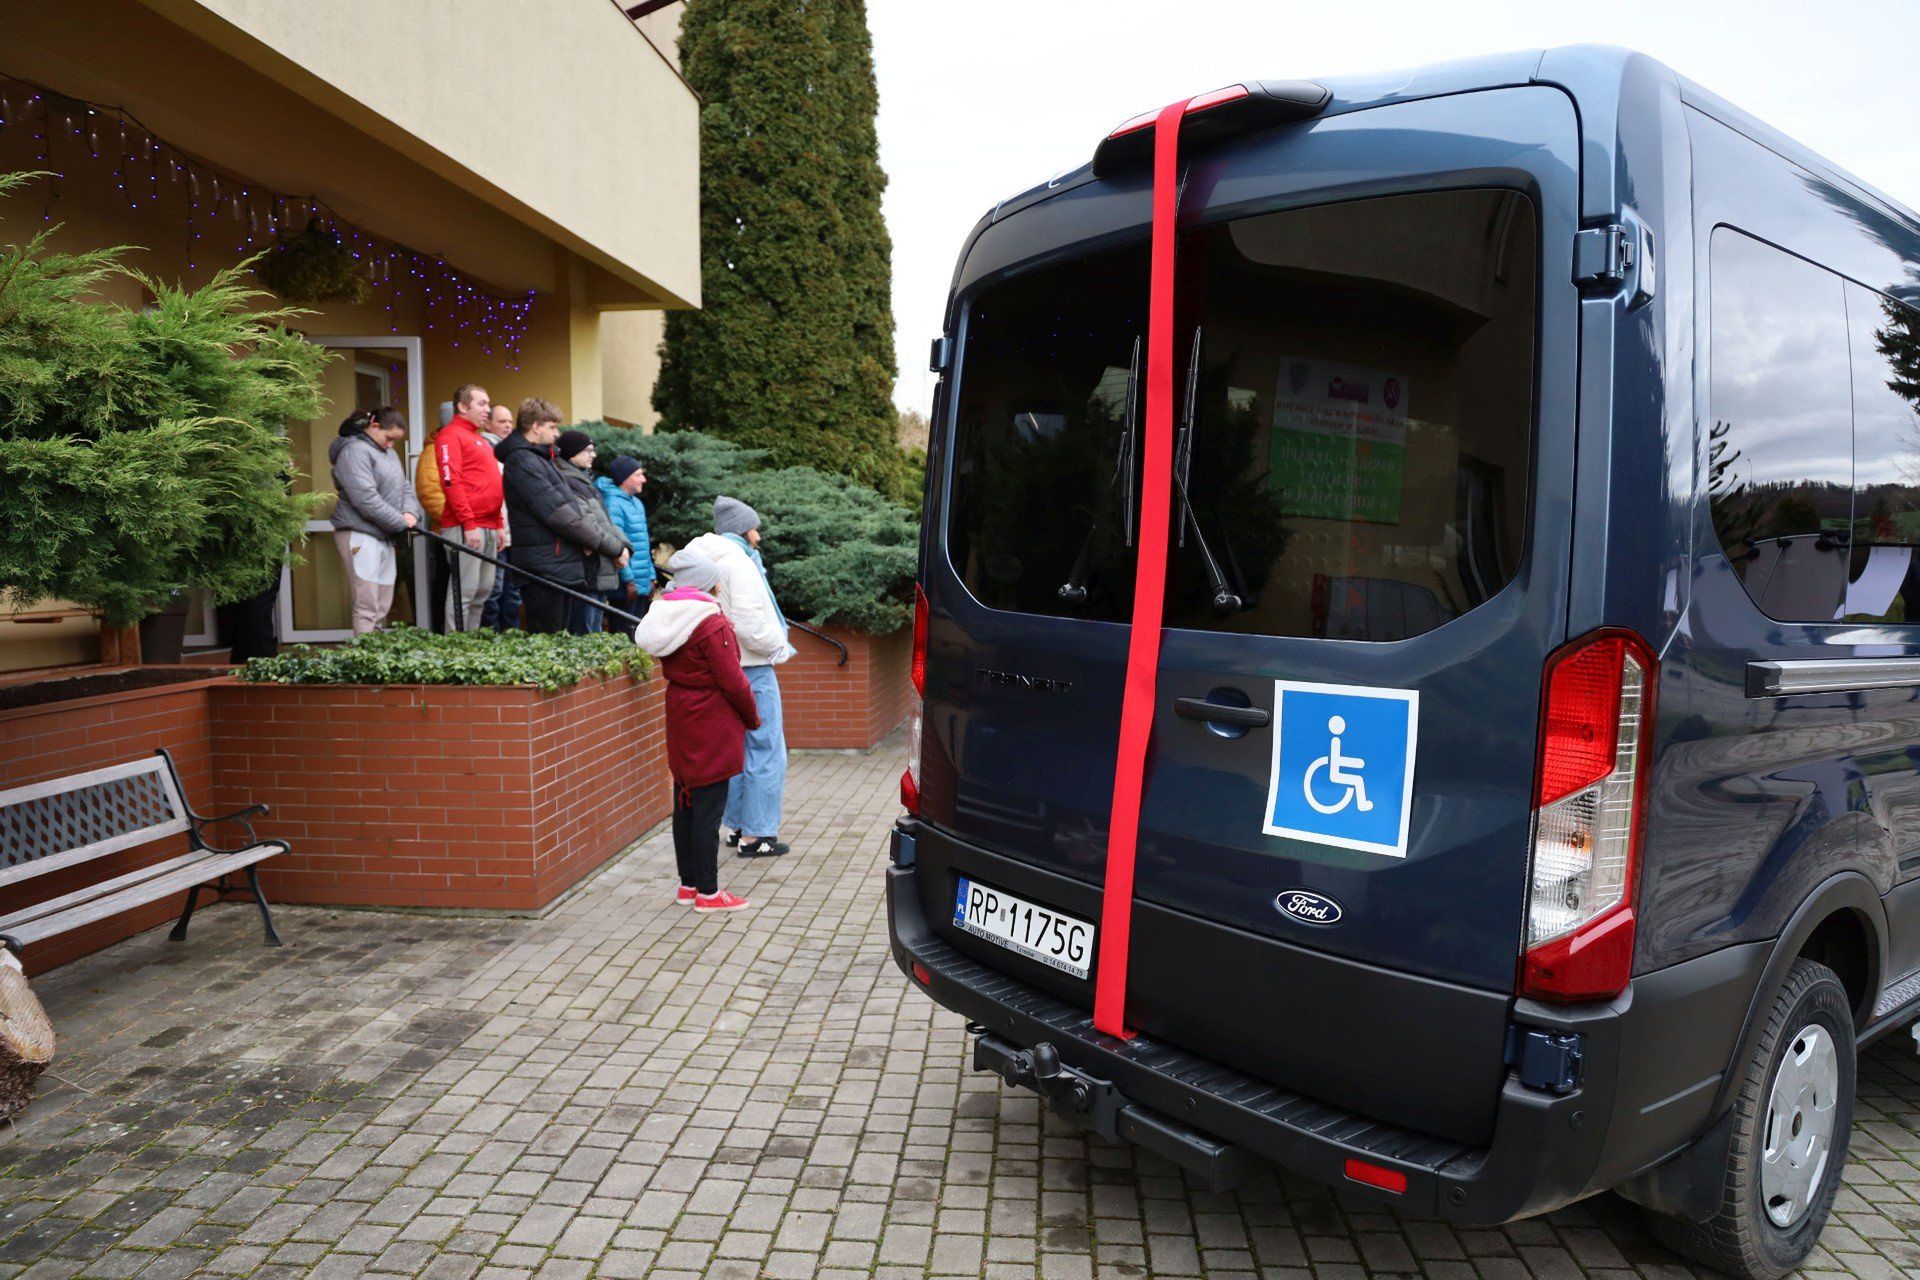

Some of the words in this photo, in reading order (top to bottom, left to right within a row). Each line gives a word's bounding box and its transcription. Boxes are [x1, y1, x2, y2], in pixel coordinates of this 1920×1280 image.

[957, 903, 965, 915] PL
[1287, 894, 1329, 919] Ford
[968, 925, 985, 938] AUTO
[985, 932, 1009, 948] MOTIVE
[969, 887, 999, 926] RP
[1009, 902, 1086, 962] 1175G
